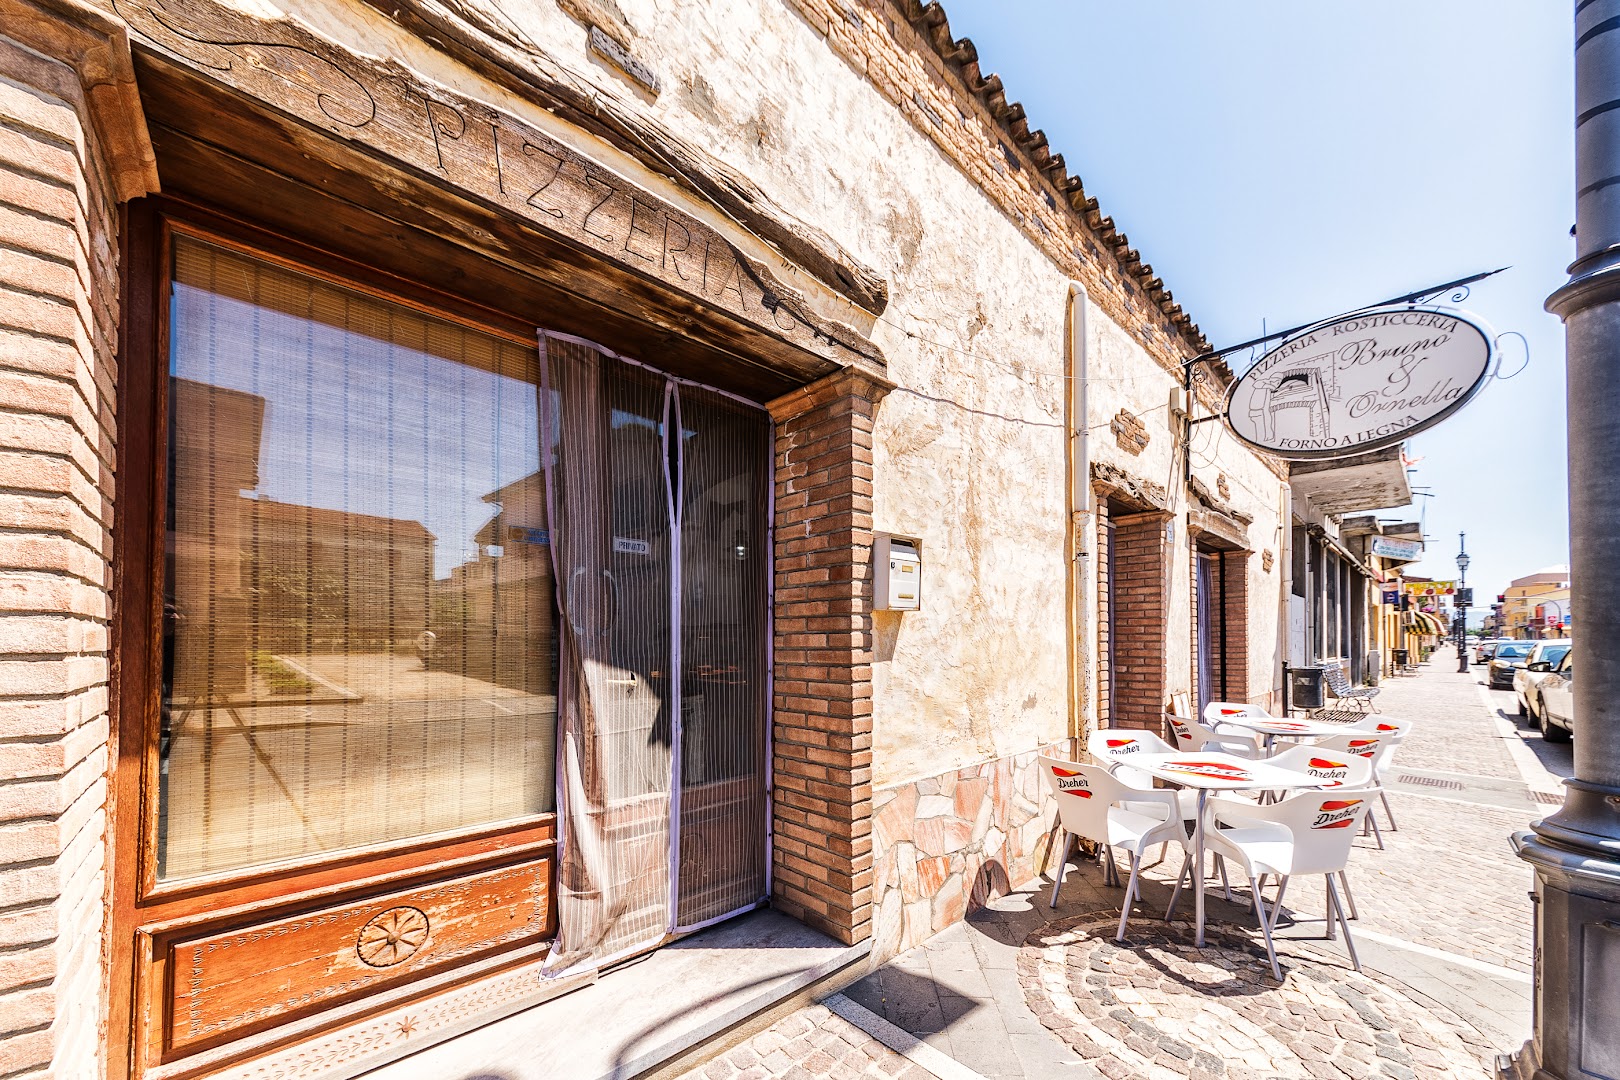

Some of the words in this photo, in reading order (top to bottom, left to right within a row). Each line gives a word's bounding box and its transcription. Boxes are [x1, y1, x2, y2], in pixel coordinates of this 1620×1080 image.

[422, 97, 749, 313] PIZZERIA
[1247, 335, 1319, 382] PIZZERIA
[1332, 313, 1460, 337] ROSTICCERIA
[1337, 334, 1452, 371] Bruno
[1381, 354, 1429, 398] &
[1345, 377, 1466, 419] Ornella
[1279, 437, 1338, 450] FORNO
[1341, 435, 1353, 447] A
[1356, 415, 1421, 443] LEGNA
[618, 541, 646, 552] PRIVATO
[1056, 777, 1090, 789] Dreher
[1312, 806, 1361, 826] Dreher
